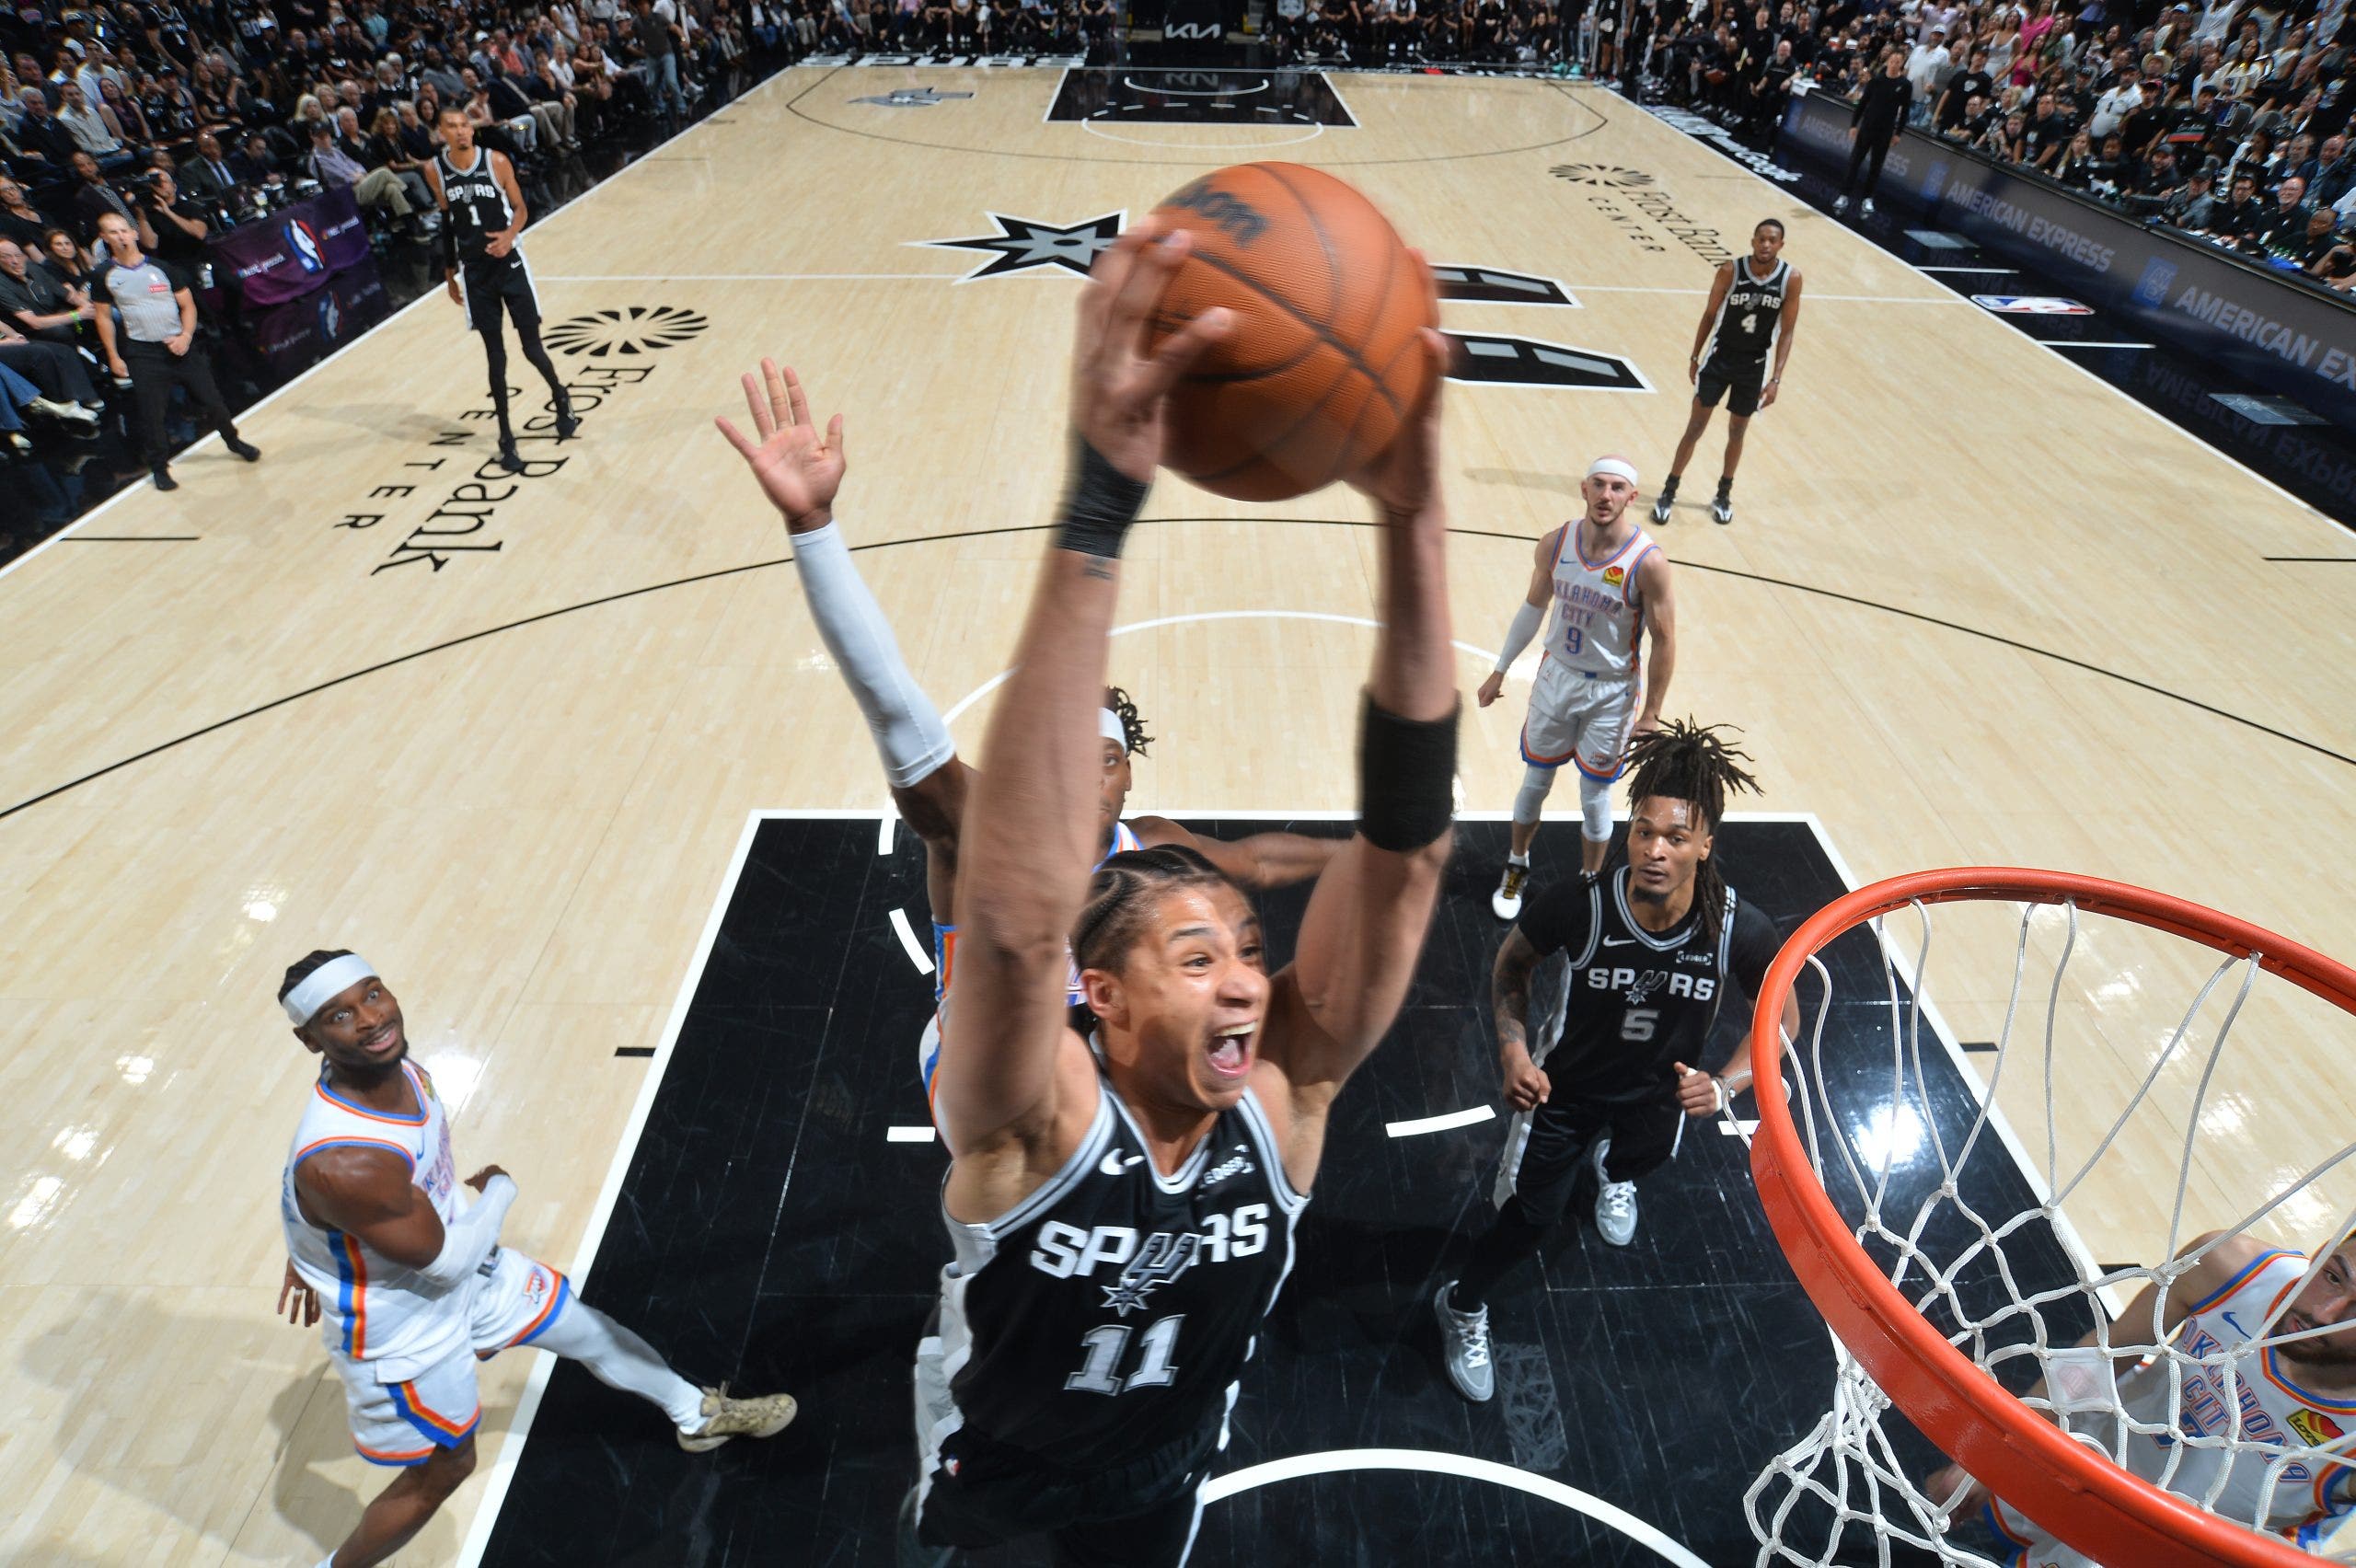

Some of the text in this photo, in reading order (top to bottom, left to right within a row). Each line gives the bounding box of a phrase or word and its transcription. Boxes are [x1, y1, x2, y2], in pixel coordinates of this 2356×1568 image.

[468, 204, 482, 226] 1
[1945, 179, 2027, 234] AMERICAN
[2027, 216, 2116, 273] EXPRESS
[1740, 314, 1758, 334] 4
[2173, 285, 2319, 367] AMERICAN
[332, 386, 524, 530] CENTER
[369, 455, 570, 576] Bank
[1561, 603, 1595, 628] CITY
[1564, 625, 1584, 655] 9
[1587, 967, 1715, 1005] SPURS
[1619, 1009, 1660, 1043] 5
[1029, 1203, 1270, 1281] SPURS
[1062, 1313, 1186, 1398] 11
[2180, 1375, 2246, 1450] CIT
